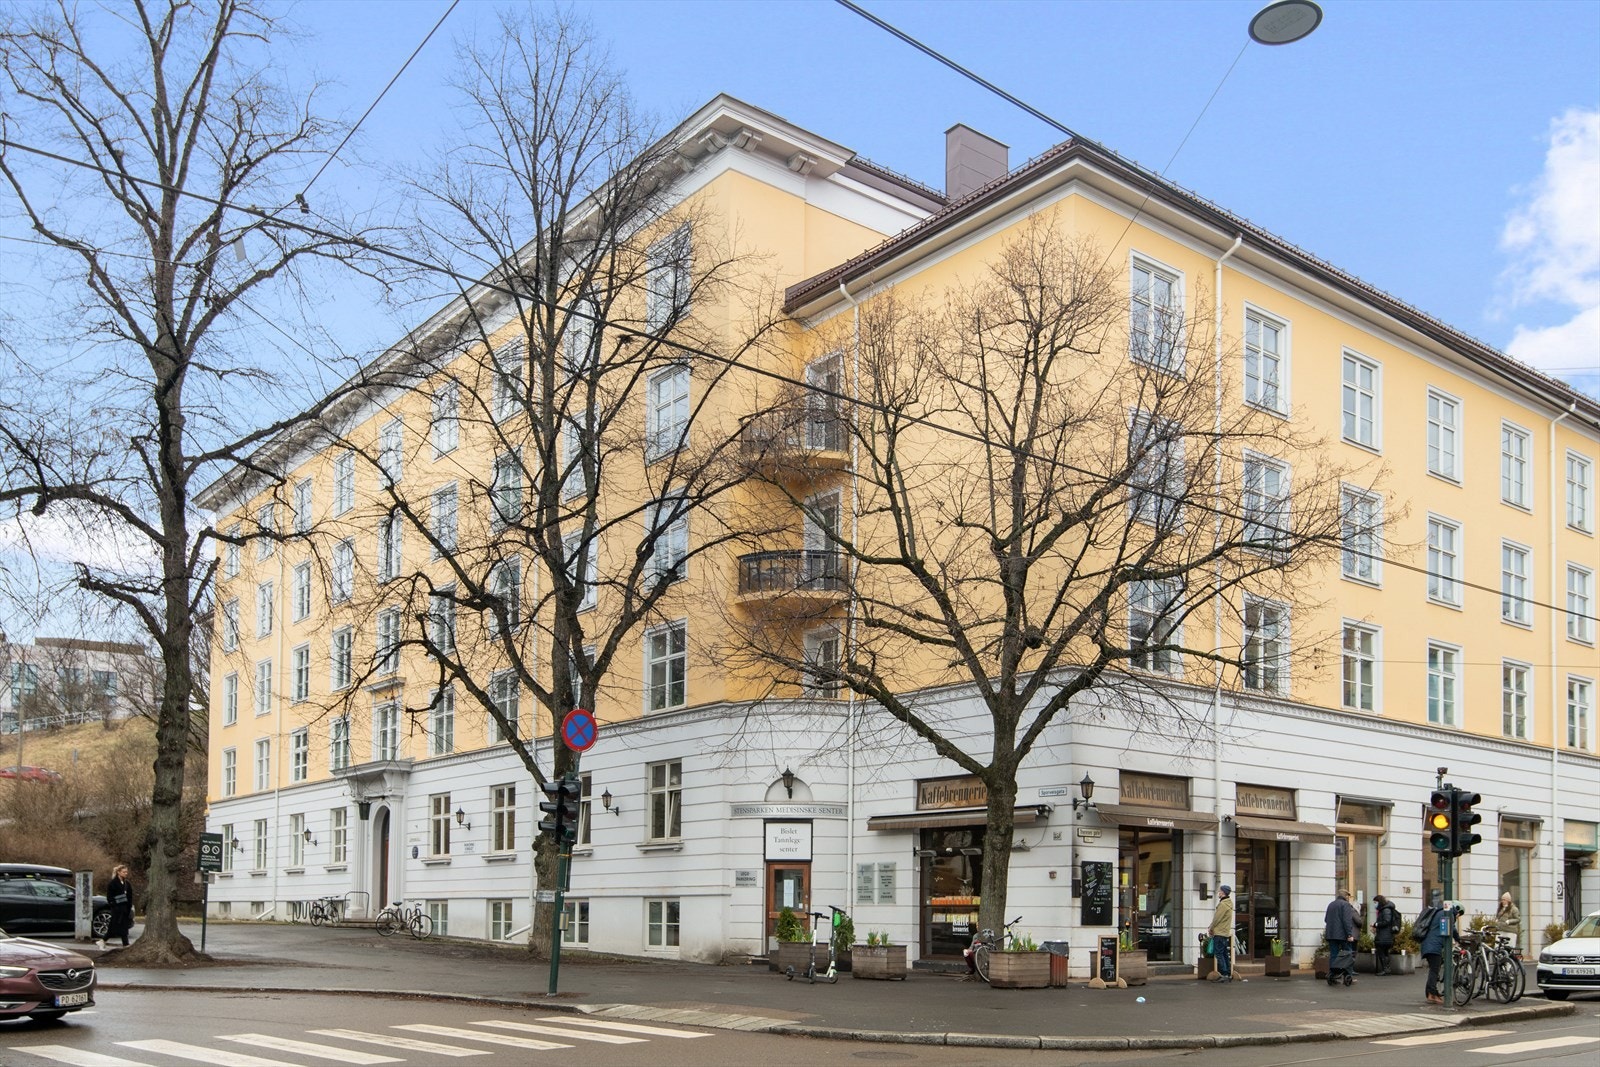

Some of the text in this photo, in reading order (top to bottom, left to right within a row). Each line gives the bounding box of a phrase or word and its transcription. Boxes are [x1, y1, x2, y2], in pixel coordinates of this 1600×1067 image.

[921, 782, 986, 805] Kaffebrennerie
[1120, 779, 1184, 803] Kaffebrenneriet
[1236, 791, 1292, 812] Kaffebrenneriet
[734, 806, 843, 815] STENSPARKEN MEDISINSKE SENTER
[1147, 818, 1174, 828] Kaffebrenneriet
[780, 827, 798, 835] Bislet
[952, 915, 969, 926] Kaffe
[1152, 915, 1167, 927] Kaffe
[1264, 917, 1278, 928] Kaffe
